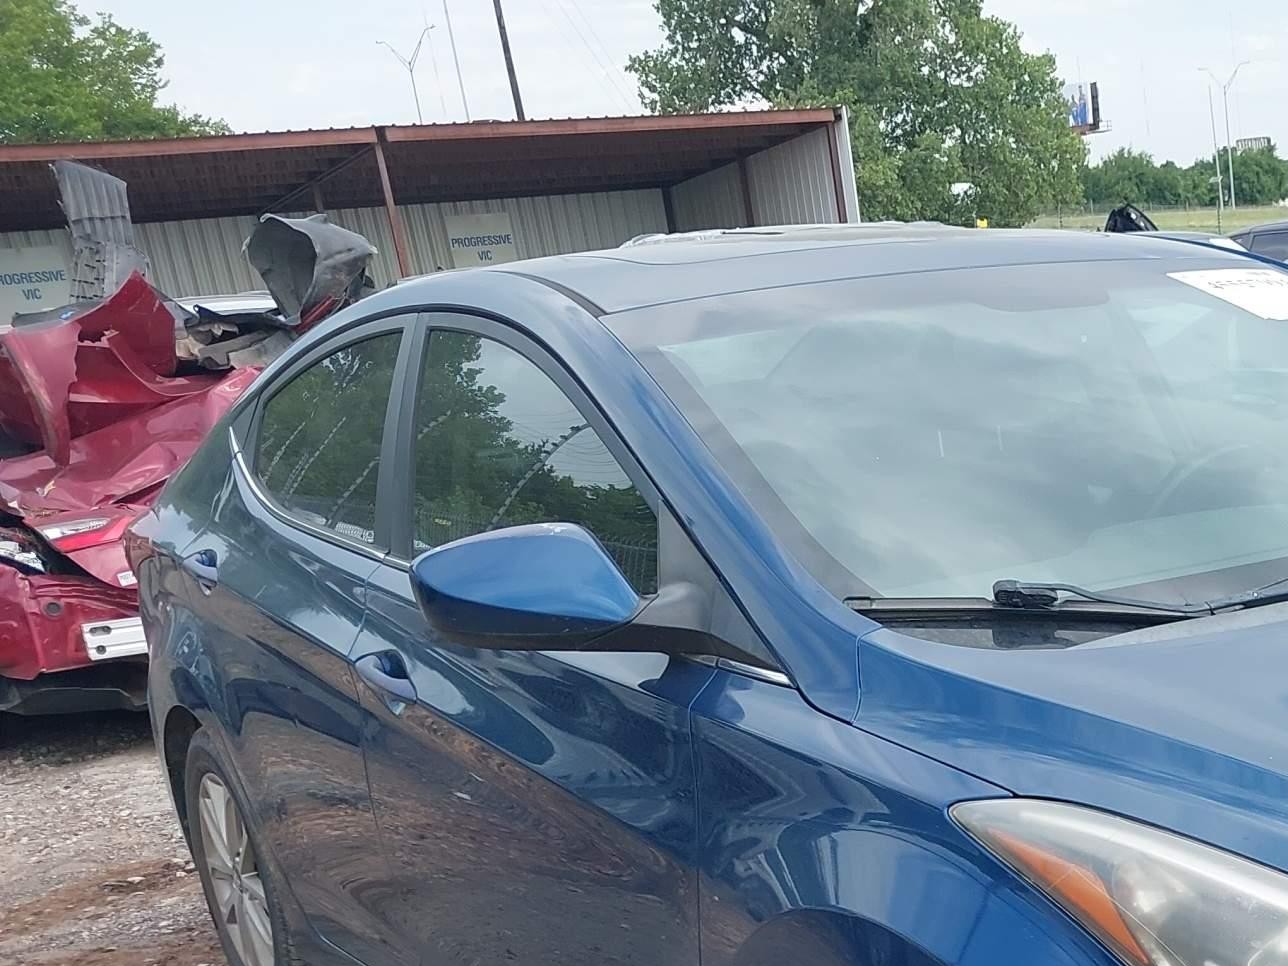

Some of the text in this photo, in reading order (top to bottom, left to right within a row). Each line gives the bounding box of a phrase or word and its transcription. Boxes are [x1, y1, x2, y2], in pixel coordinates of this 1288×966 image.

[451, 234, 513, 248] PROGRESSIVE
[477, 250, 493, 261] VIC
[0, 269, 66, 286] ROGRESSIVE
[22, 288, 42, 300] VIC
